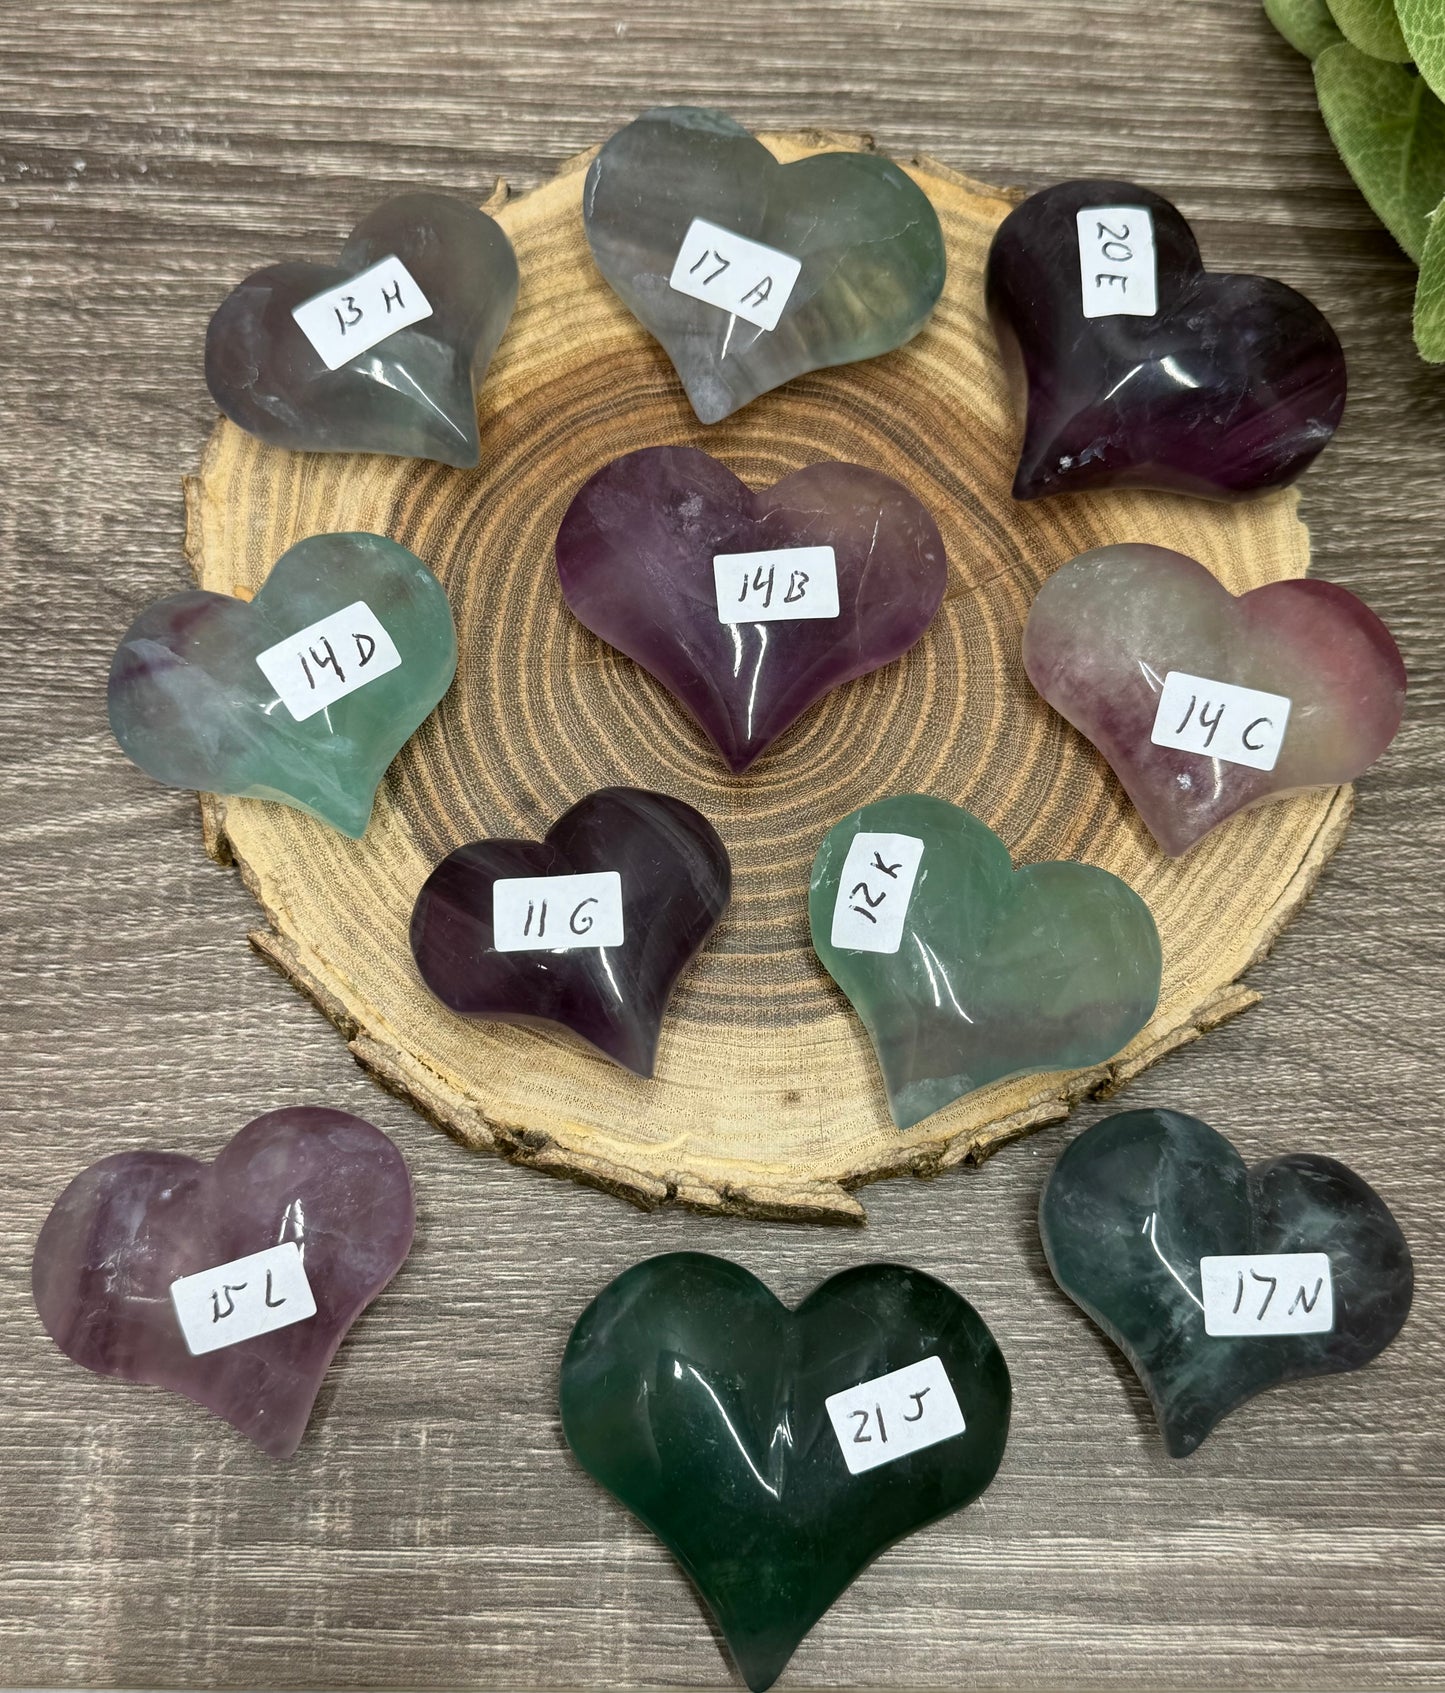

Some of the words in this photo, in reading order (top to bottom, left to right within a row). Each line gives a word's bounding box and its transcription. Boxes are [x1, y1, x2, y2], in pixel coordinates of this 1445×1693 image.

[689, 249, 731, 286] 17
[739, 275, 773, 309] A
[333, 296, 364, 337] 13
[380, 279, 406, 314] H
[1171, 694, 1227, 751] 14
[1241, 716, 1274, 751] C
[523, 898, 548, 938] 11
[568, 896, 599, 936] G
[208, 1281, 249, 1324] 15
[264, 1268, 288, 1309] L
[846, 1402, 889, 1444] 21
[902, 1386, 932, 1423] J
